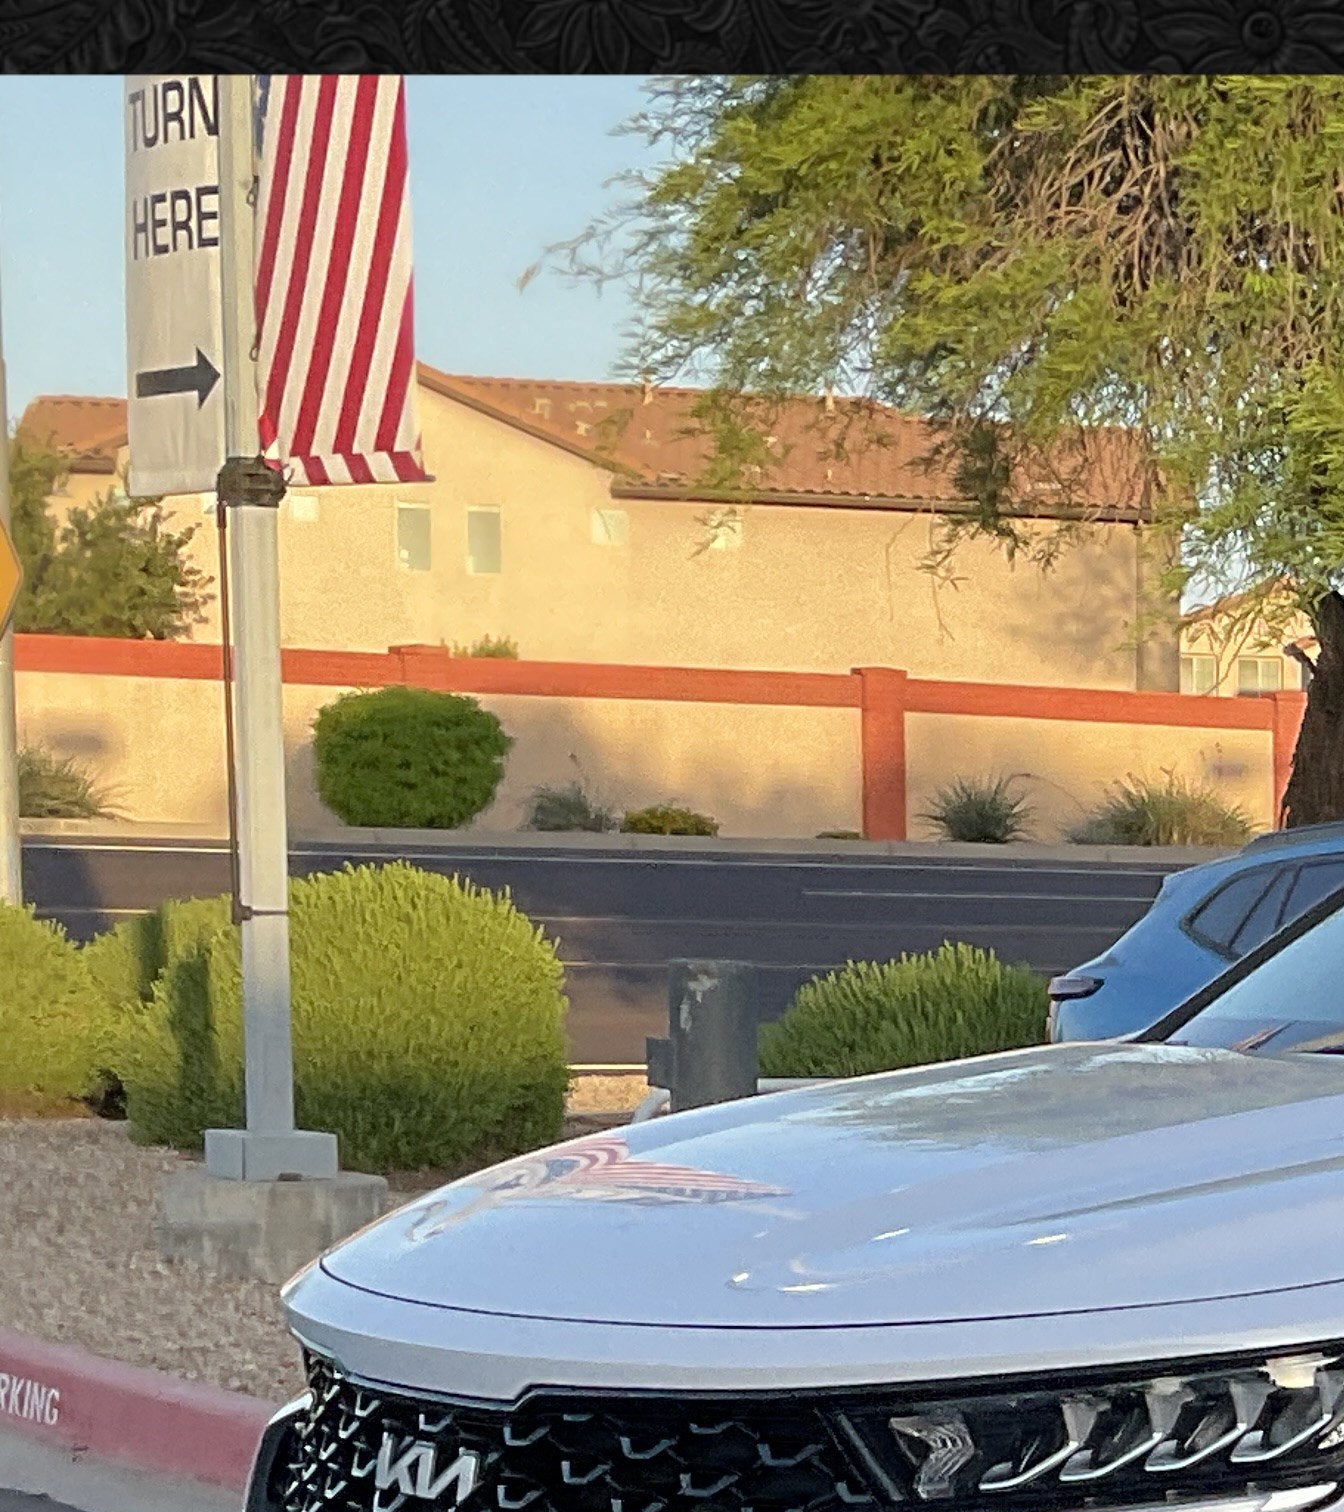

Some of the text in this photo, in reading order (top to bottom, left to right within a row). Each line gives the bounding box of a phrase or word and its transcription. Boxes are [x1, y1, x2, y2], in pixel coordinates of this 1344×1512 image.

[129, 74, 219, 152] TURN
[133, 186, 219, 260] HERE
[375, 1432, 478, 1504] KIA
